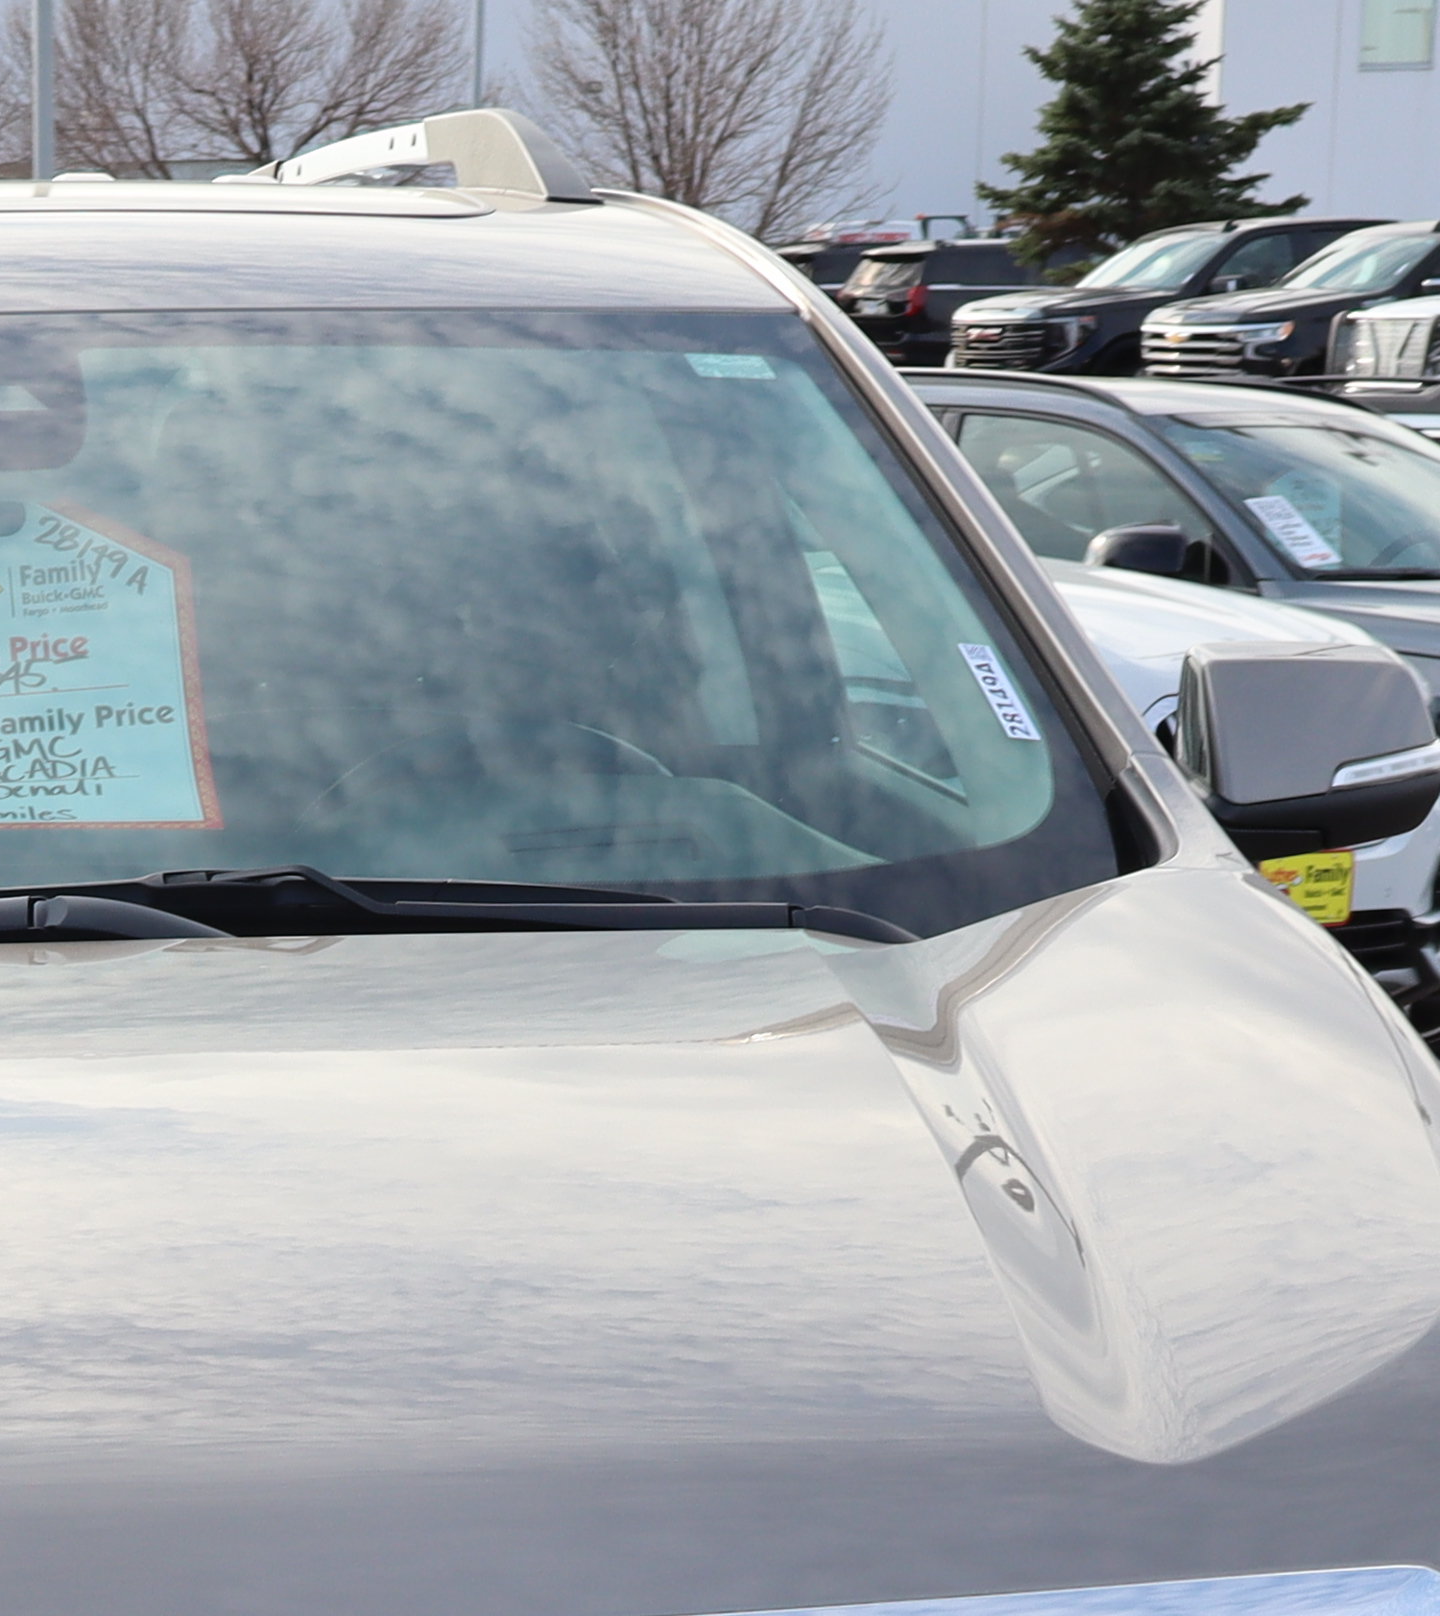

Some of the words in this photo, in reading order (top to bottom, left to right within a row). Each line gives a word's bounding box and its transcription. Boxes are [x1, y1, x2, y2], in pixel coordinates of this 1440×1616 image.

[20, 559, 102, 587] Family
[9, 634, 89, 664] Price
[974, 663, 1031, 736] 28149A
[95, 702, 176, 728] Price
